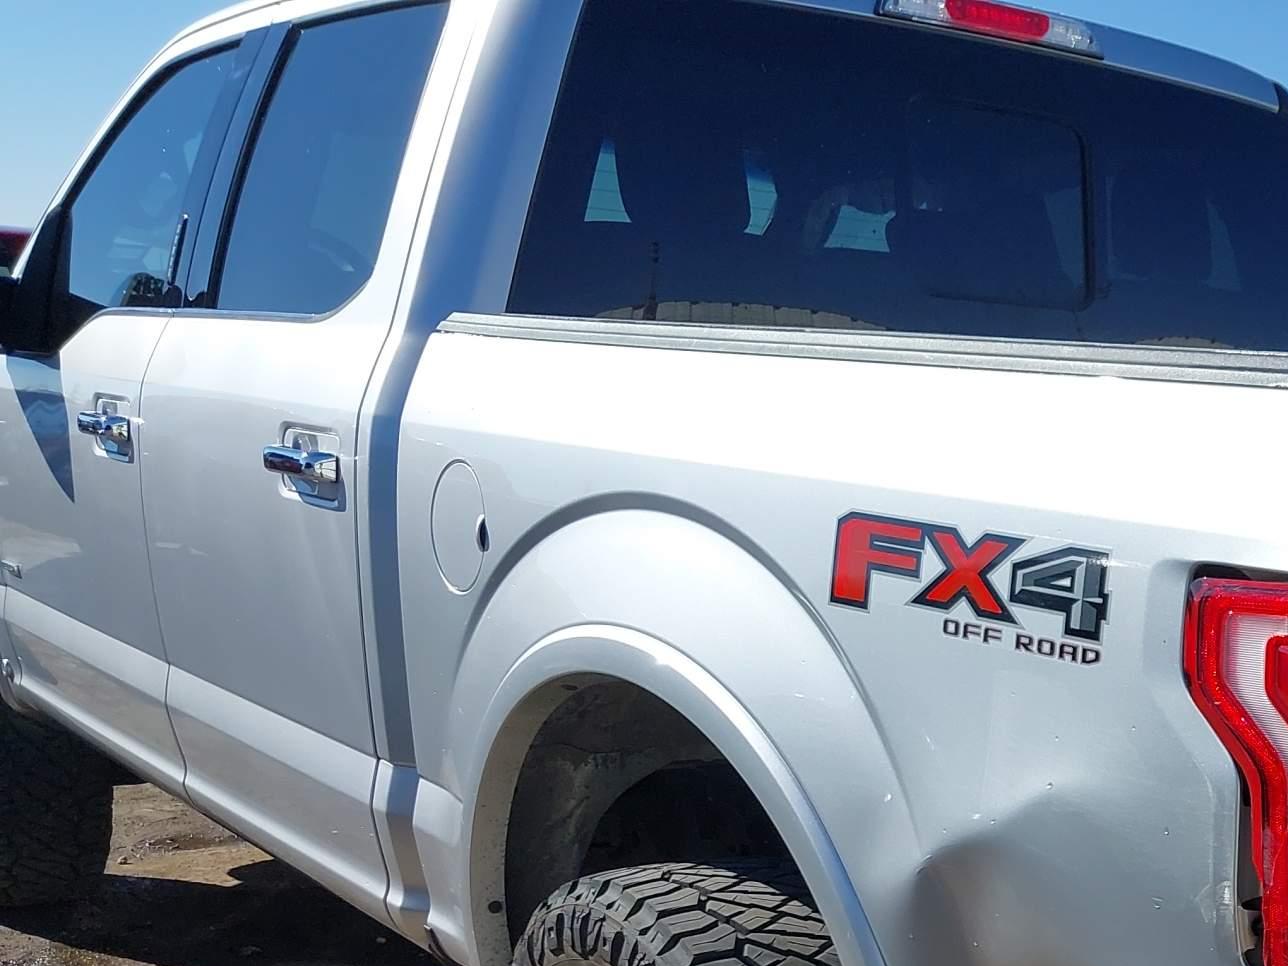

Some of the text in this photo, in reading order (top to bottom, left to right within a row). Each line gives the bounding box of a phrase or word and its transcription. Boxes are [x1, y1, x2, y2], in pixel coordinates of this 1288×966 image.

[828, 509, 1111, 643] FX4
[943, 618, 1102, 665] OFF ROAD
